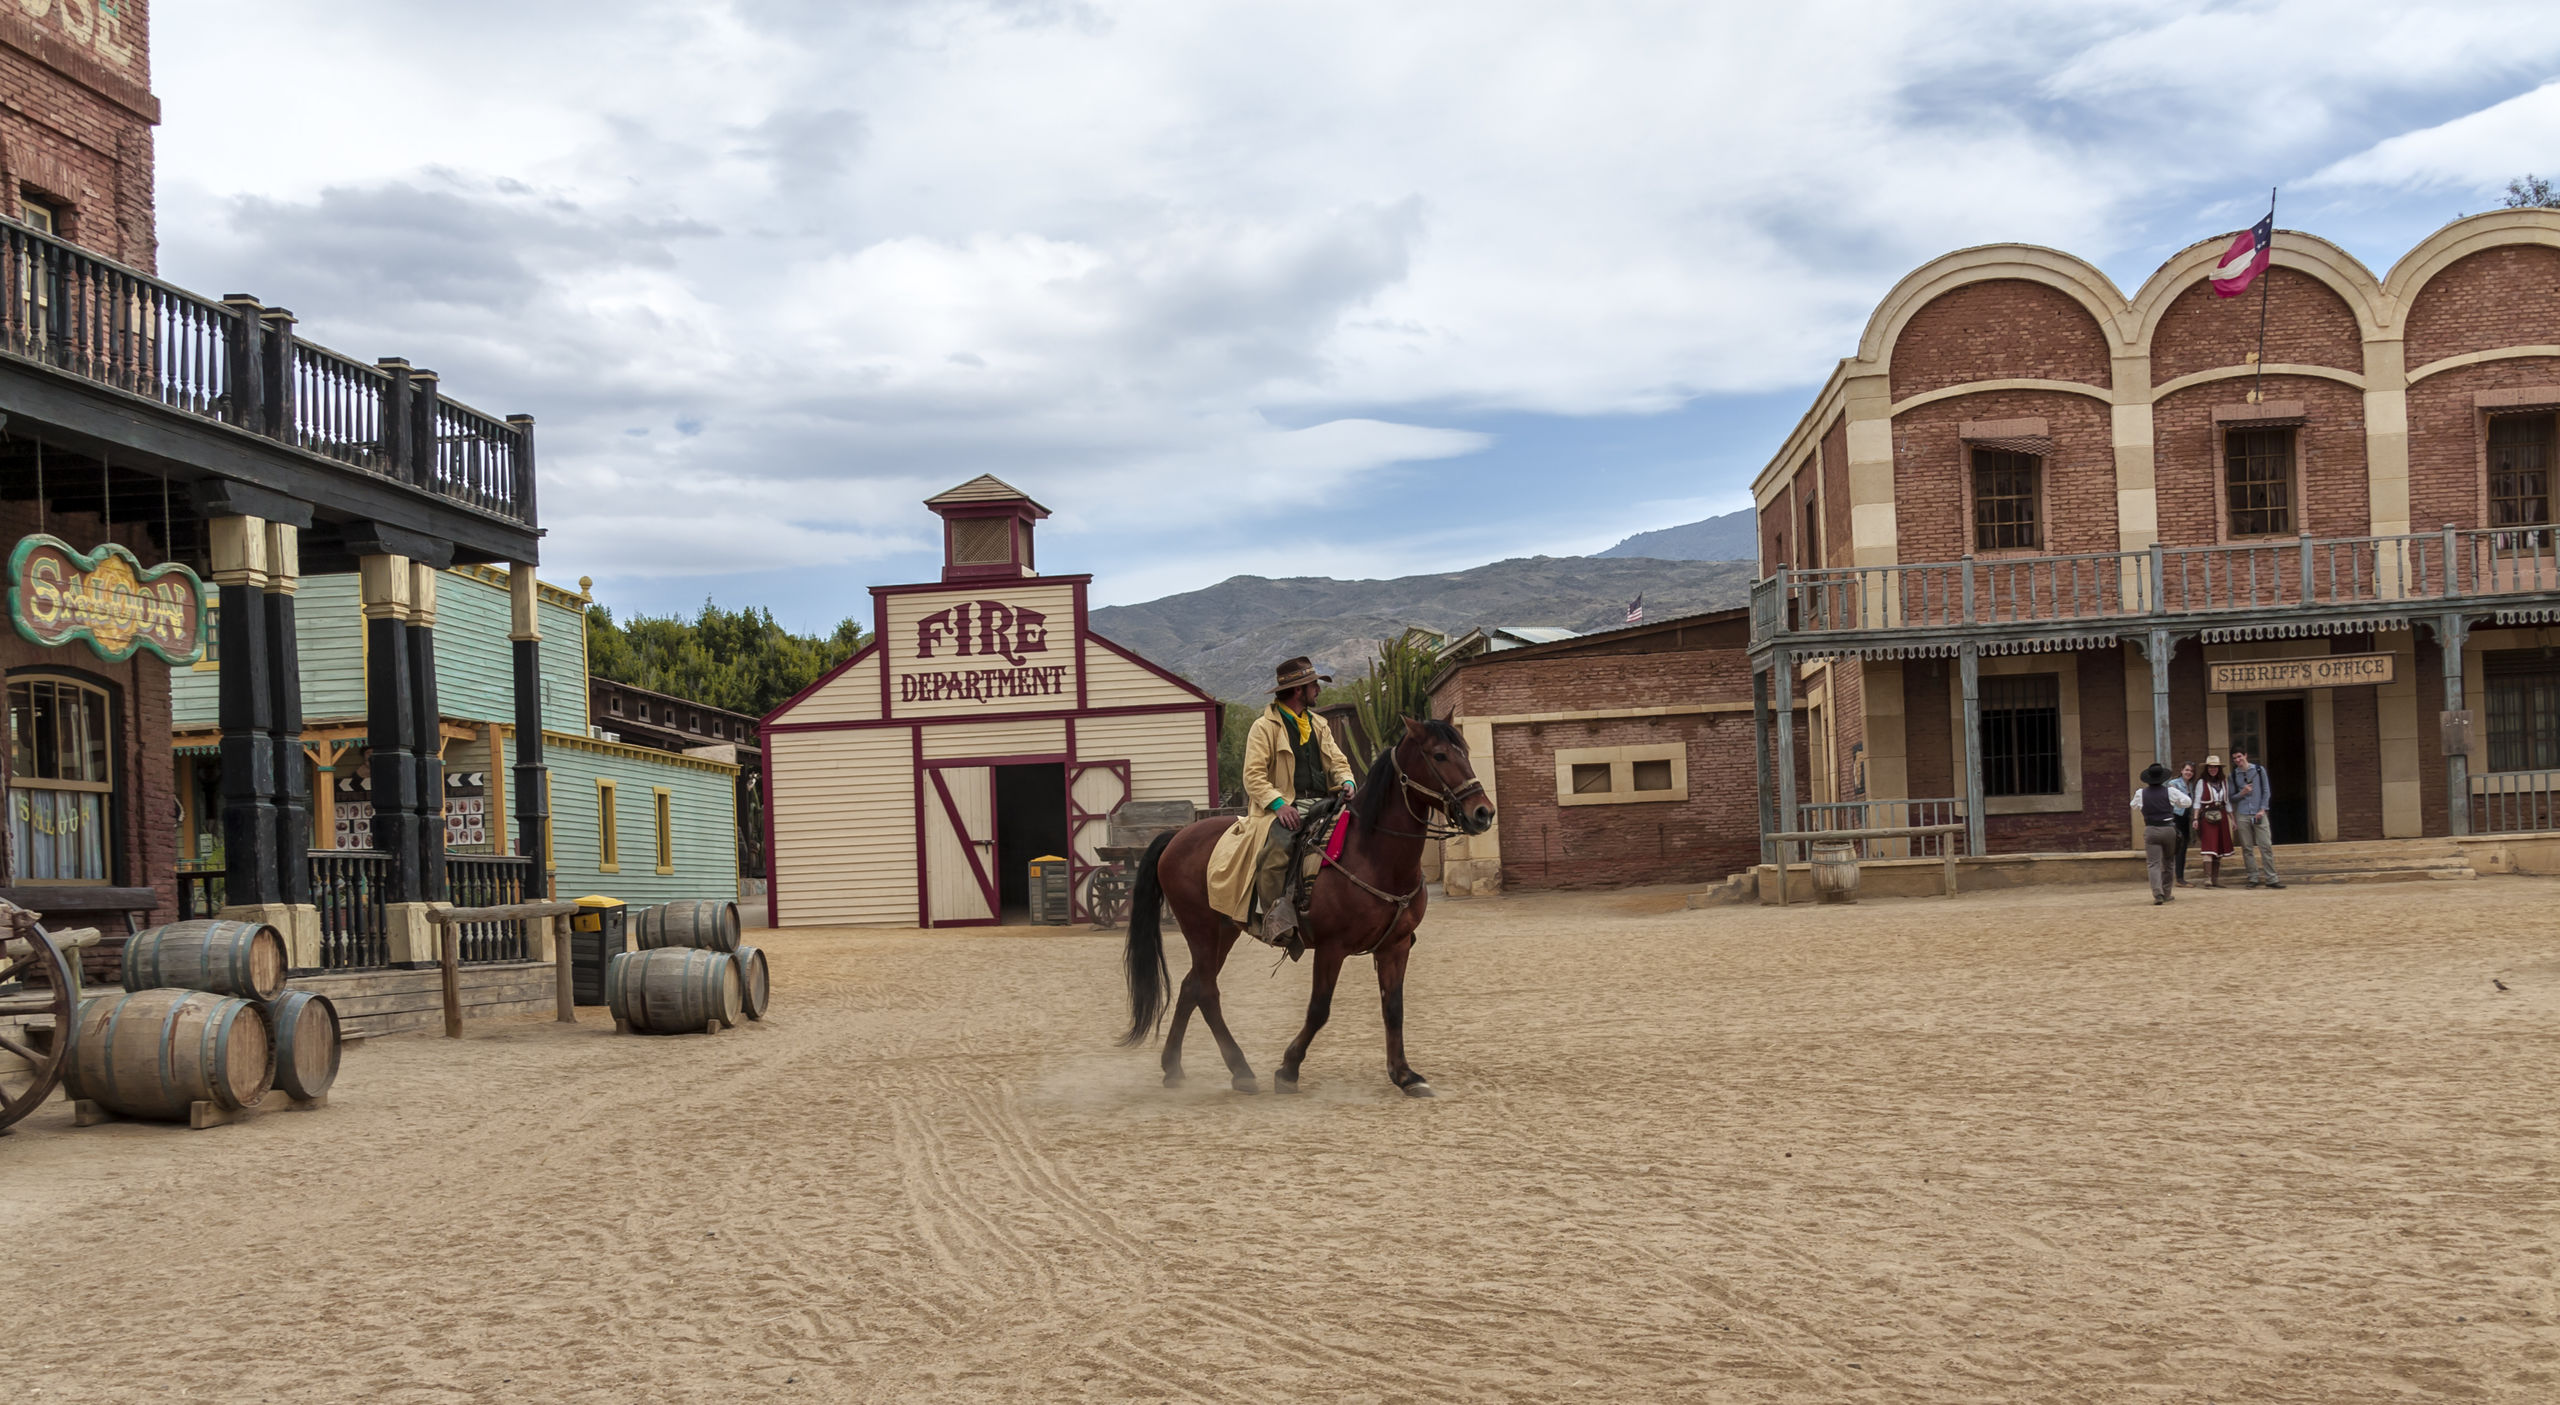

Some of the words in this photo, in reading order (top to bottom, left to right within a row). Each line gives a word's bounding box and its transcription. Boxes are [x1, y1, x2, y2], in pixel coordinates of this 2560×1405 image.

[30, 557, 187, 640] SALOON
[916, 601, 1048, 666] FIRE
[901, 666, 1067, 703] DEPARTMENT
[2218, 663, 2312, 682] SHERIFF'S
[2318, 659, 2384, 678] OFFICE
